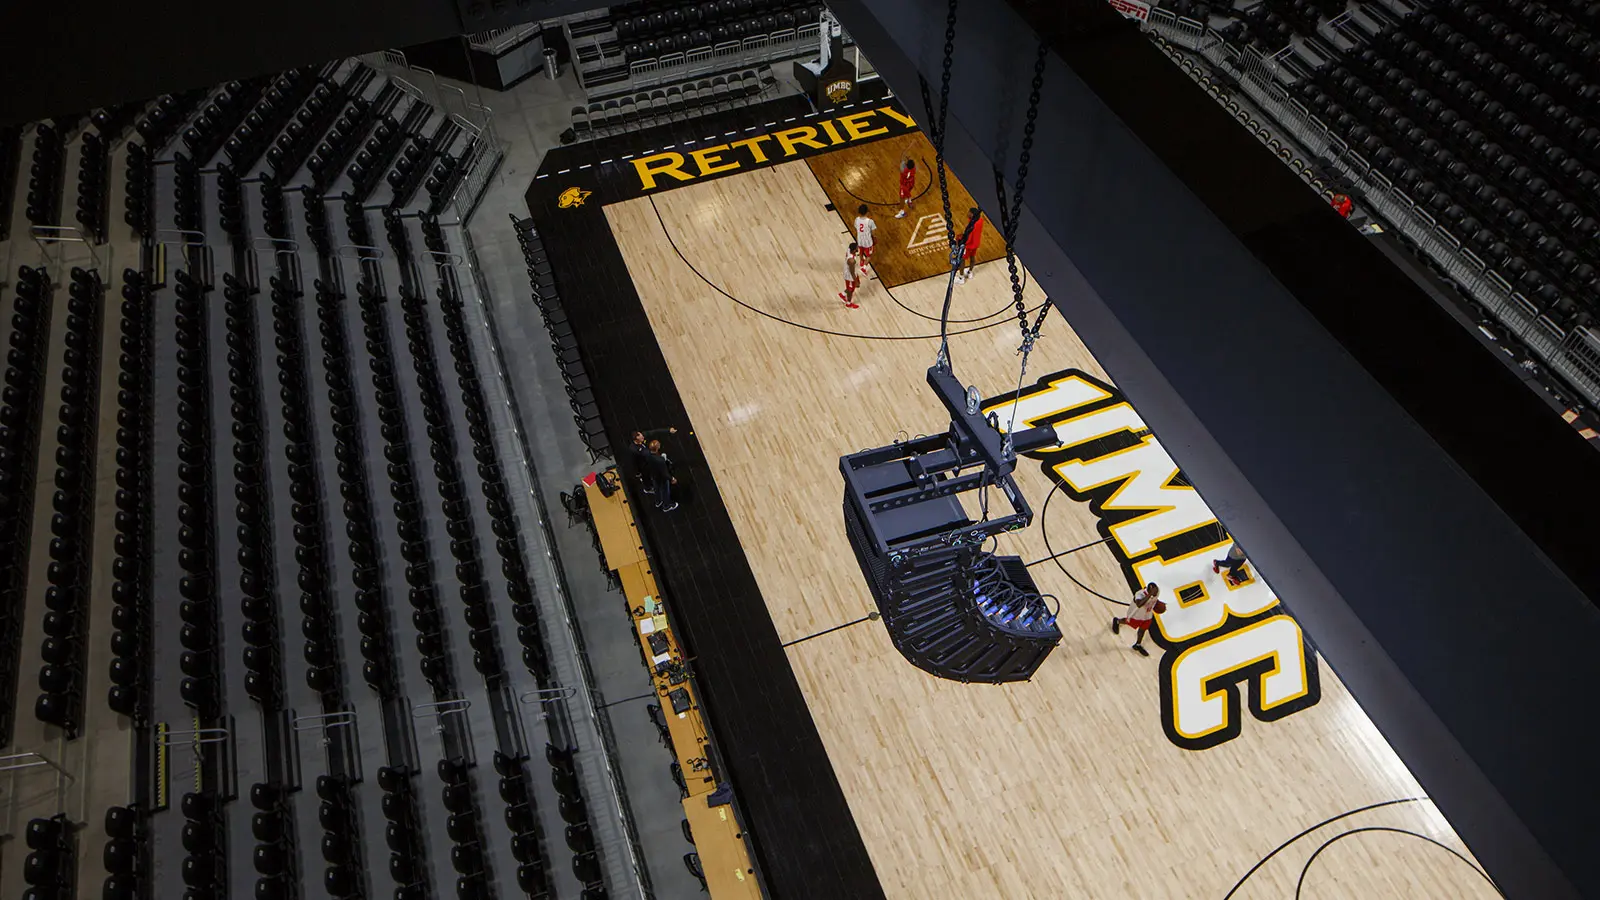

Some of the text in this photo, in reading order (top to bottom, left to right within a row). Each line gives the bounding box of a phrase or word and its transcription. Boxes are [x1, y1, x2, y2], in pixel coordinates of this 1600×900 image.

[827, 81, 851, 95] UMBC
[859, 223, 865, 233] 2
[977, 371, 1313, 744] UMBC
